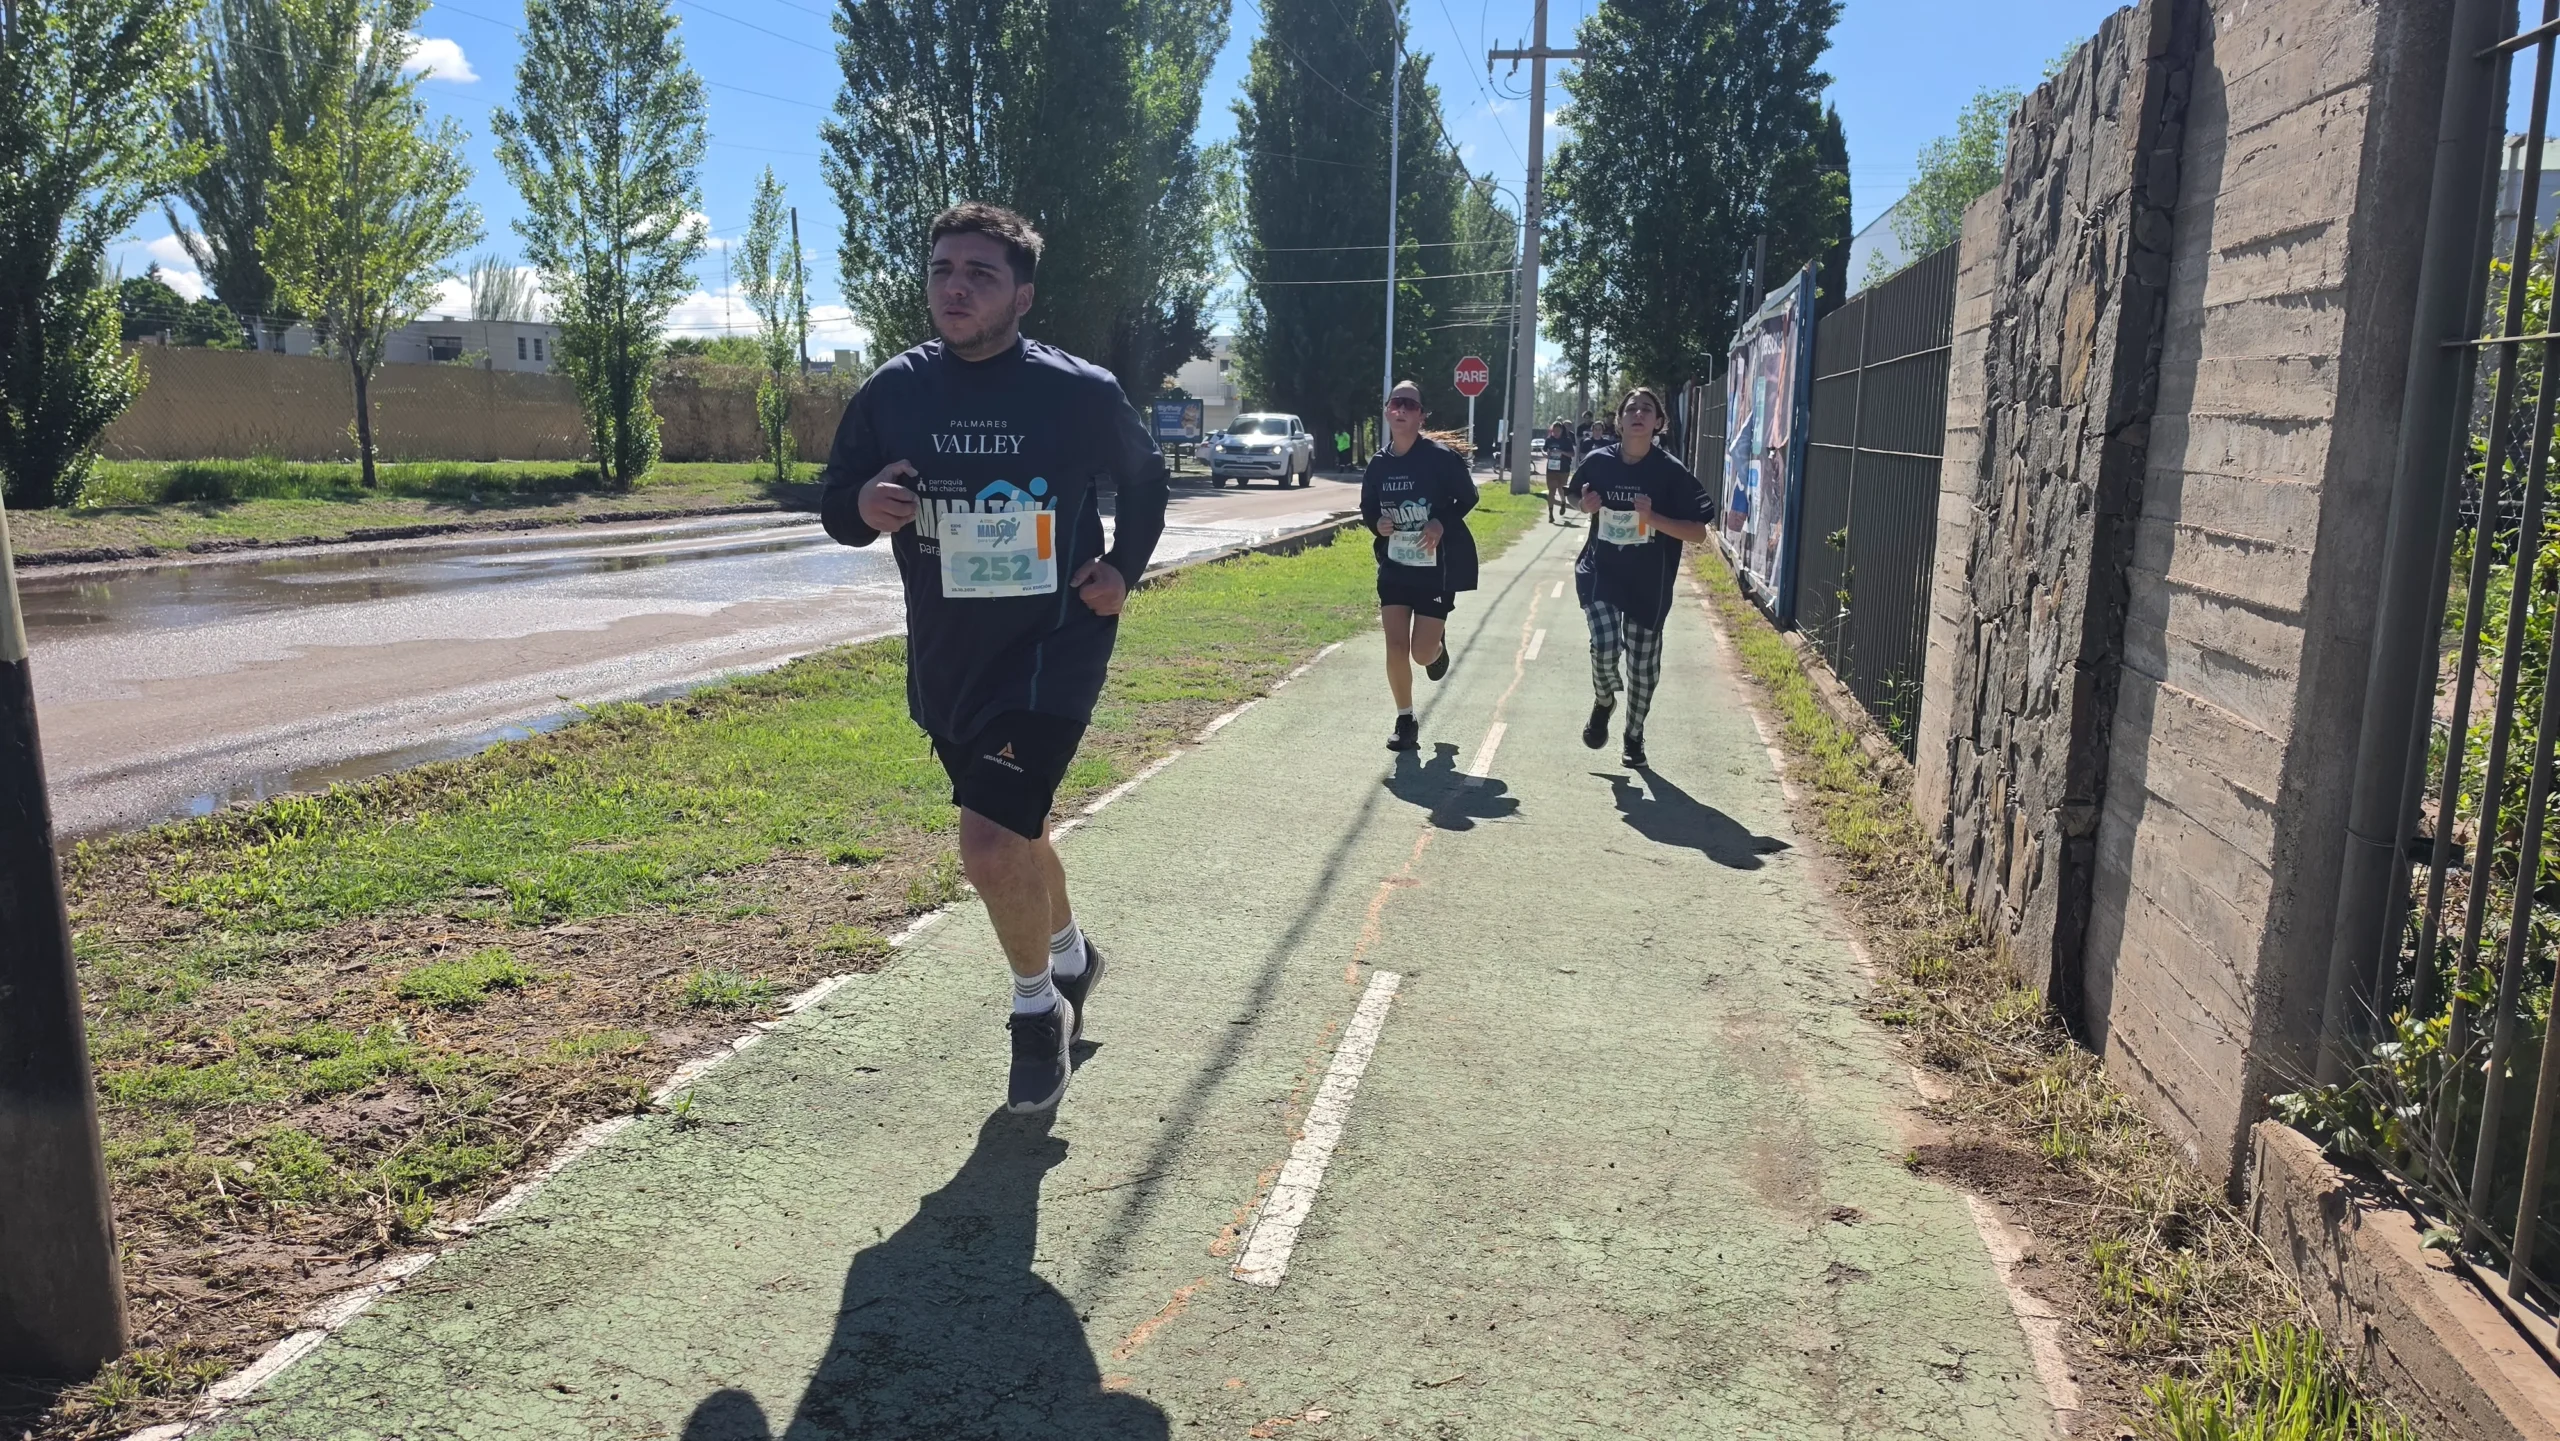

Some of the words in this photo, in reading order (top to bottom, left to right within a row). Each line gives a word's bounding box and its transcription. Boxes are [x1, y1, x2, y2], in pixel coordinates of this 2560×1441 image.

[1456, 369, 1487, 383] PARE
[950, 420, 1007, 428] PALMARES
[931, 434, 1025, 454] VALLEY
[1382, 481, 1415, 492] VALLEY
[1608, 526, 1636, 538] 397
[1397, 548, 1426, 560] 506
[968, 555, 1032, 581] 252
